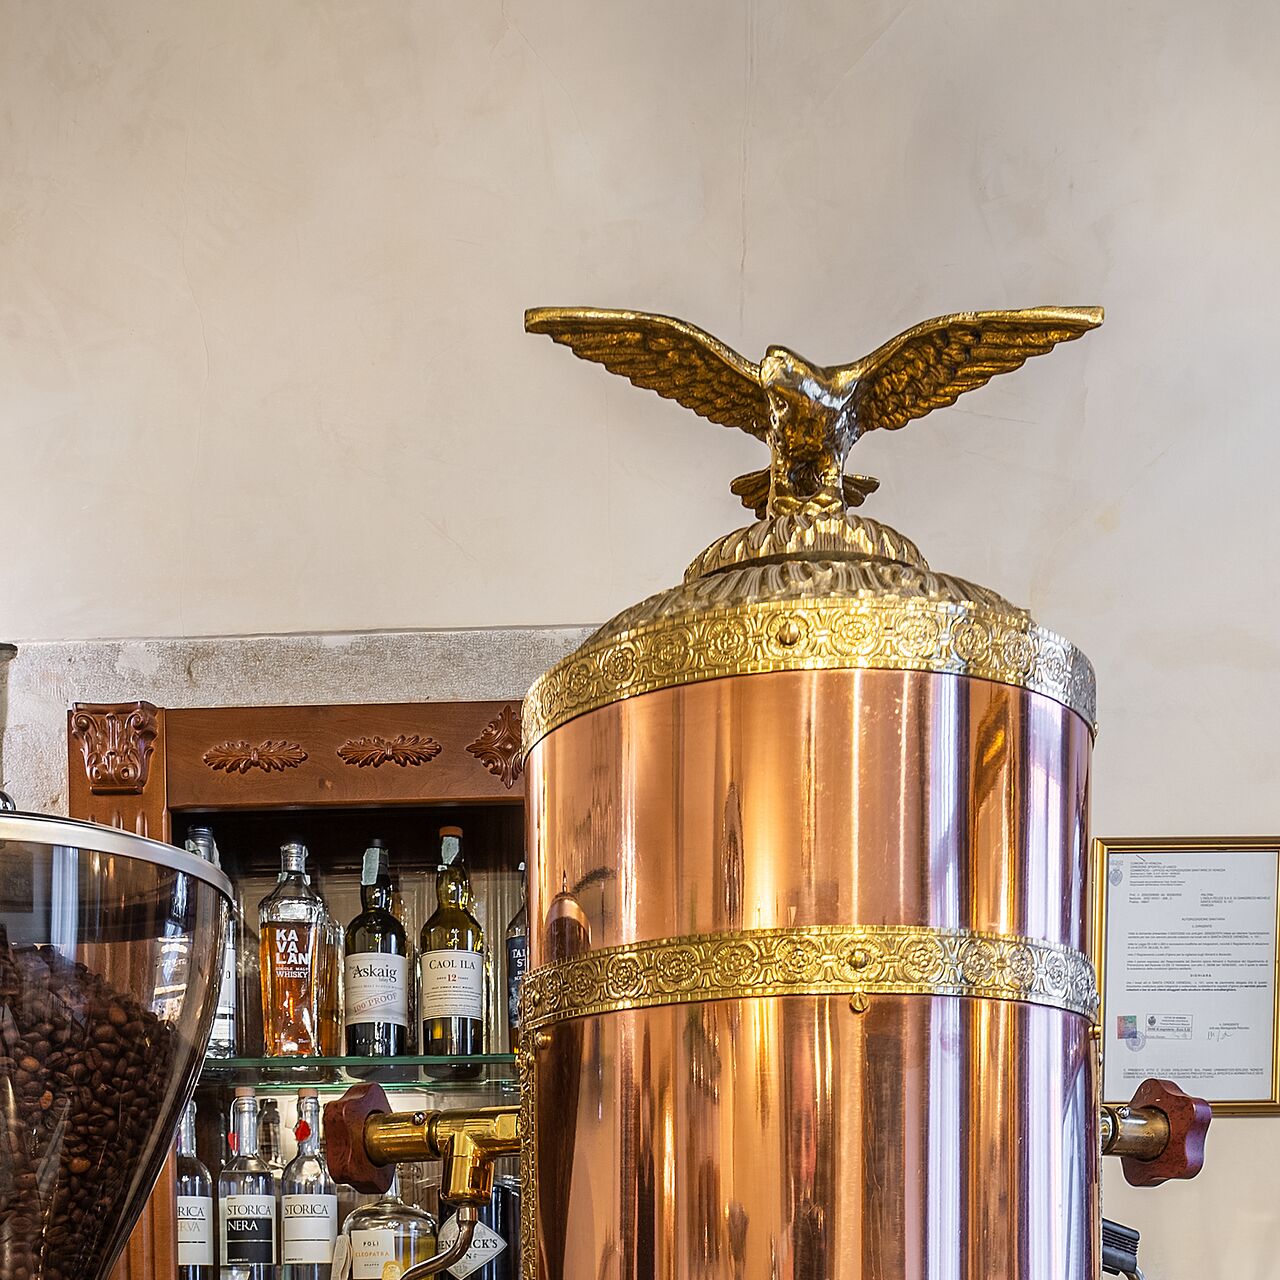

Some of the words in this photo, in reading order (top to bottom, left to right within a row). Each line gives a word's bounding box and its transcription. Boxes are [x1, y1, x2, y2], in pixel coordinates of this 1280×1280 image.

[276, 929, 298, 941] KA
[276, 941, 298, 953] VA
[276, 953, 309, 964] LAN
[429, 959, 457, 970] CAOL
[460, 960, 475, 970] ILA
[352, 964, 398, 983] Askaig
[448, 974, 456, 982] 12
[227, 1204, 272, 1216] STORICA
[284, 1204, 328, 1216] STORICA
[228, 1220, 258, 1231] NERA
